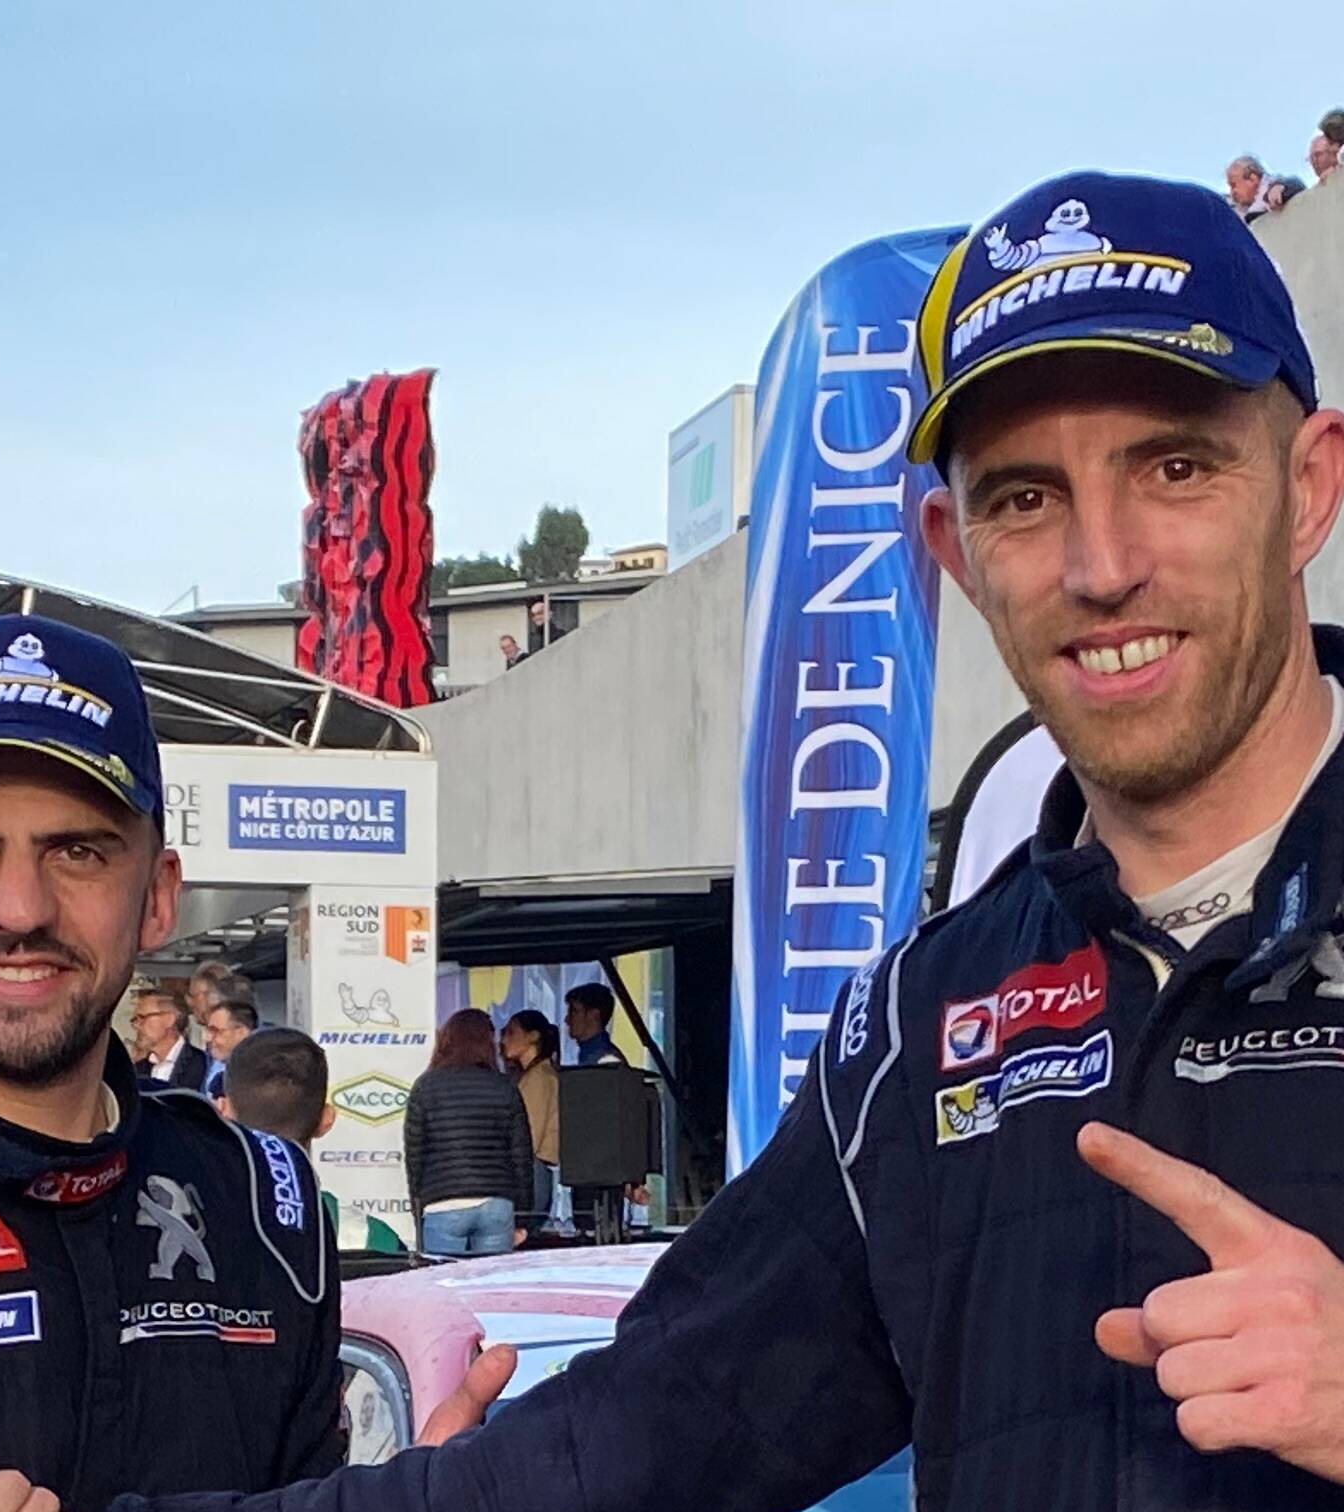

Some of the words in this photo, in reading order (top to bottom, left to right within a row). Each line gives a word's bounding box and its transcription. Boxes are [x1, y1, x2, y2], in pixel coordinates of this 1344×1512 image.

[952, 260, 1187, 359] MICHELIN
[799, 316, 916, 622] NICE
[239, 791, 395, 822] MÉTROPOLE
[239, 822, 281, 839] NICE
[285, 819, 329, 840] CÔTE
[333, 824, 394, 843] D'AZUR
[346, 920, 380, 935] SUD
[318, 1031, 428, 1046] MICHELIN
[71, 1164, 125, 1194] TOTAL
